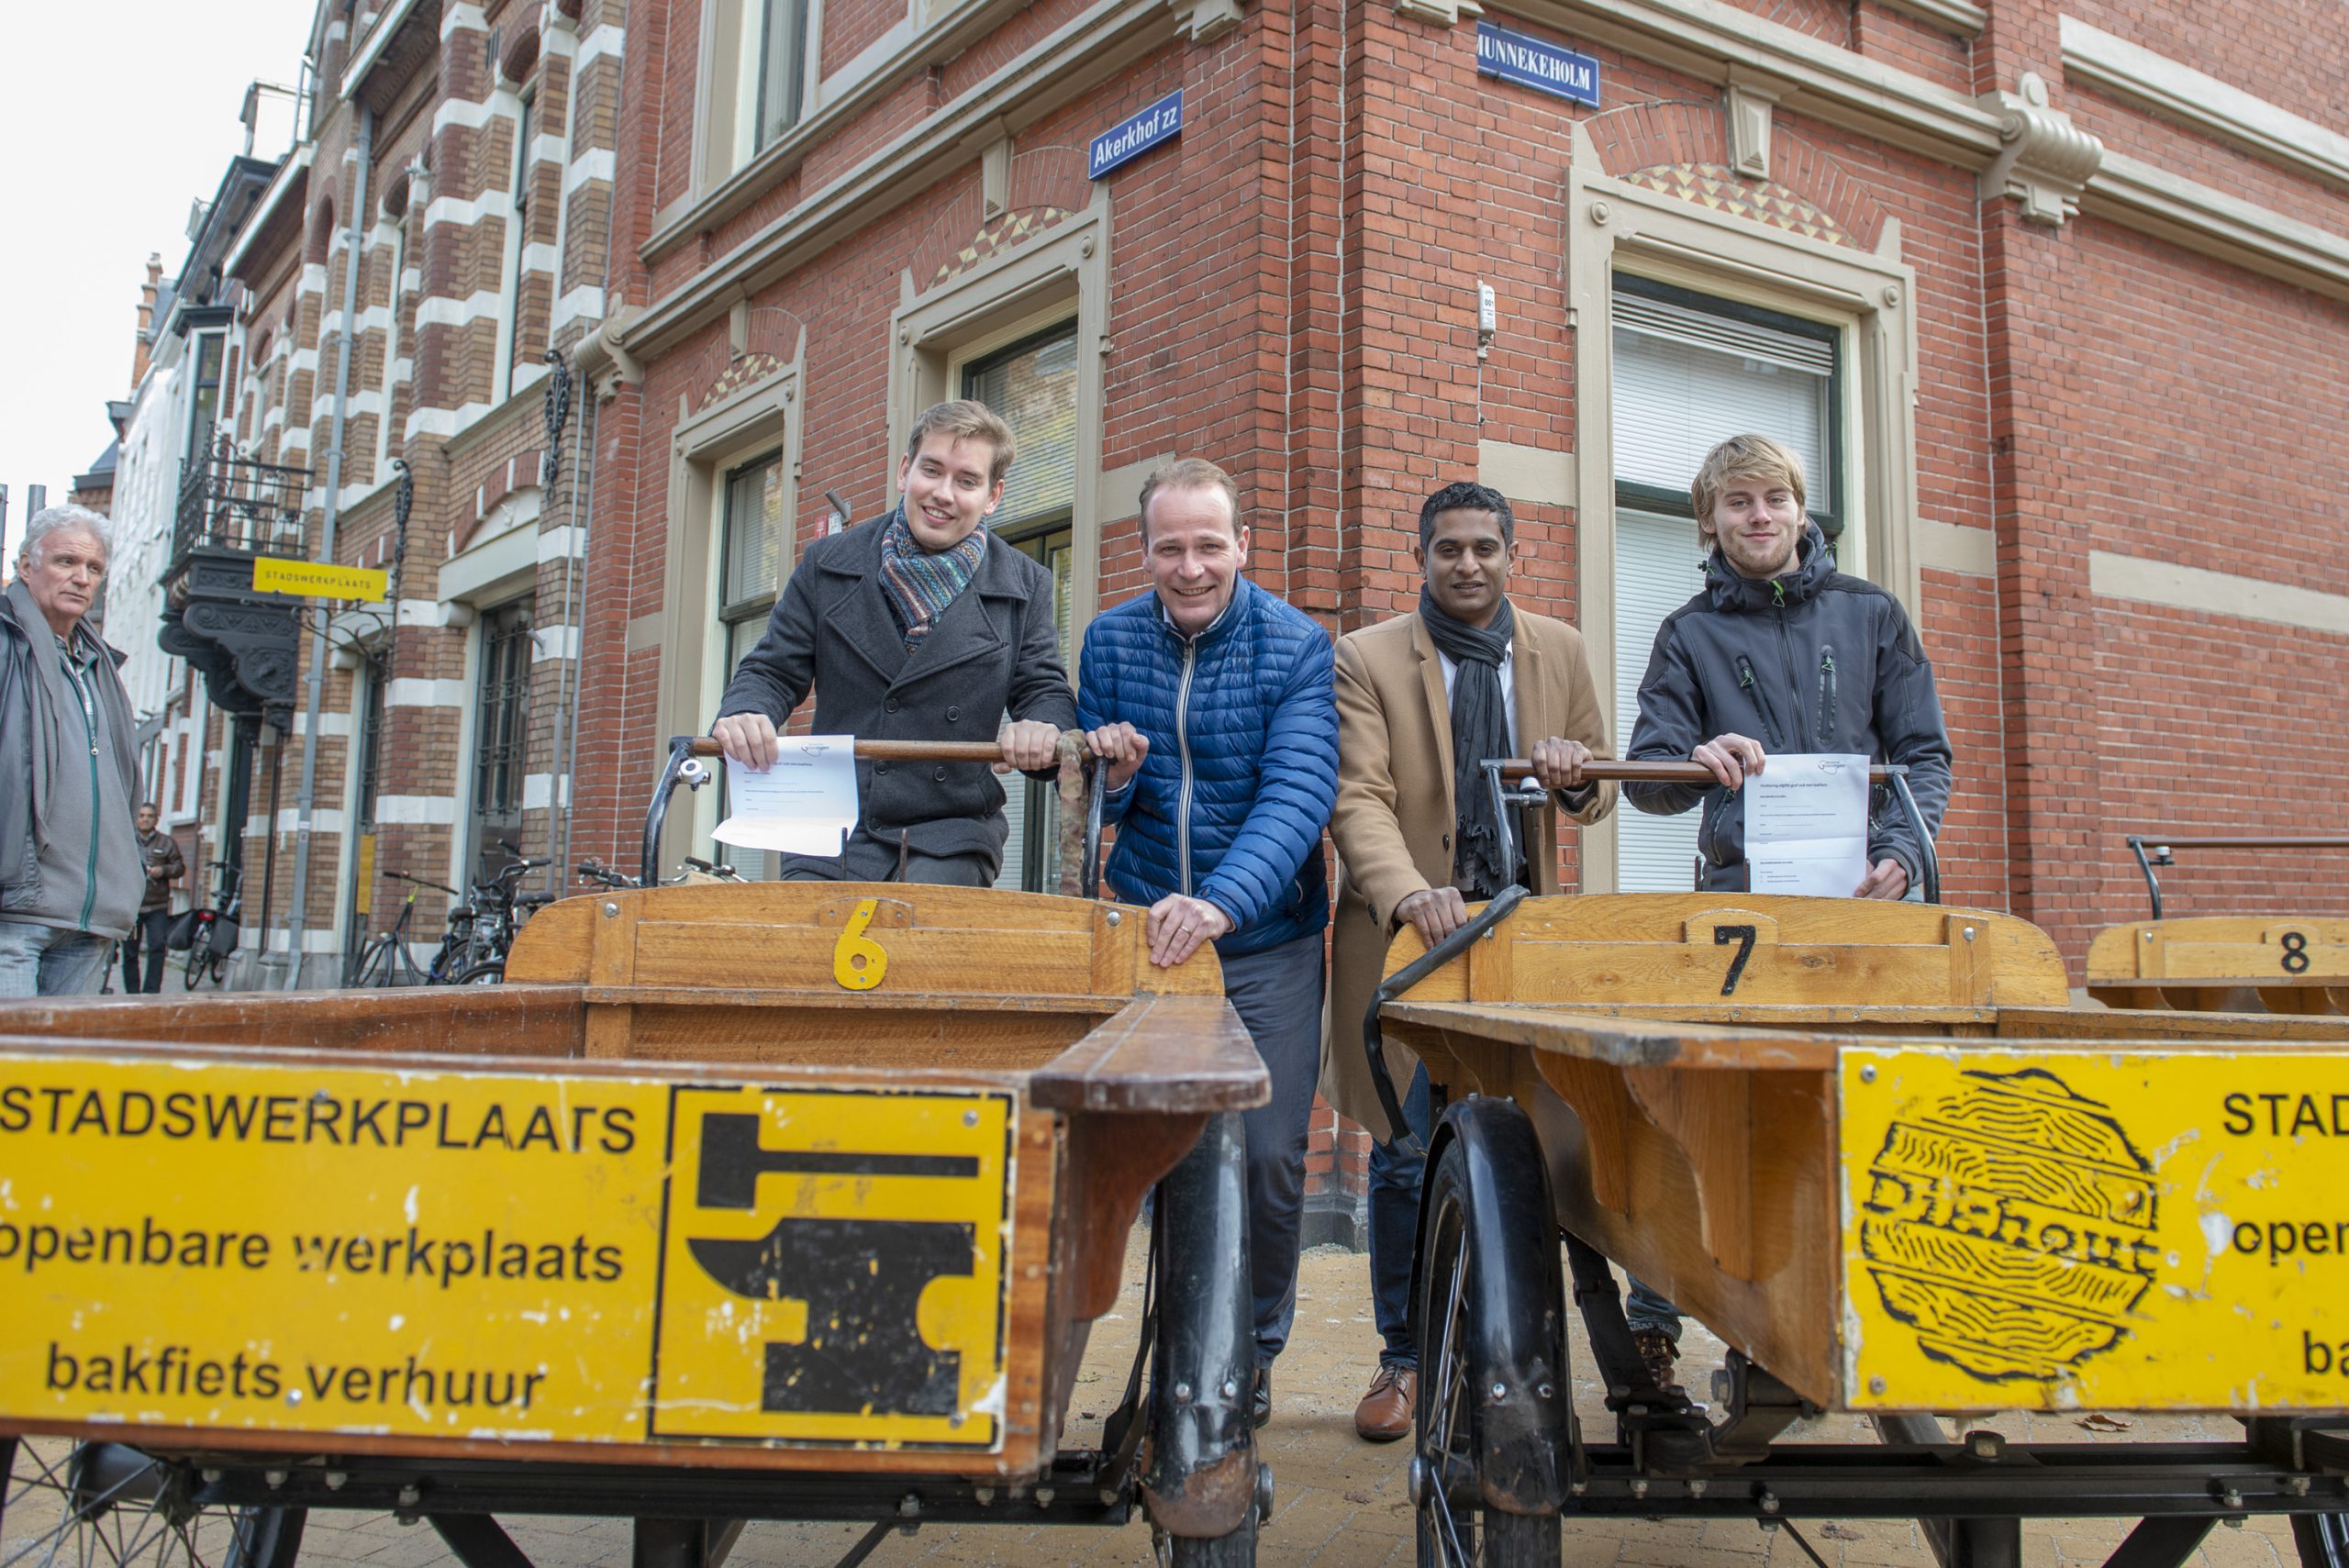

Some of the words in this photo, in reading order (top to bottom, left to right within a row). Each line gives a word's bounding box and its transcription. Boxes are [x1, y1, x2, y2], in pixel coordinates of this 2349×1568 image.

[1094, 109, 1160, 169] Akerkhof
[1162, 106, 1177, 130] zz
[264, 571, 371, 589] STADSWERKPLAATS
[833, 898, 888, 990] 6
[1713, 924, 1757, 996] 7
[2281, 931, 2310, 974] 8
[0, 1085, 637, 1154] STADSWERKPLAATS
[0, 1216, 271, 1273] openbare
[292, 1225, 624, 1290] werkplaats
[45, 1340, 282, 1399] bakfiets
[306, 1354, 548, 1408] verhuur
